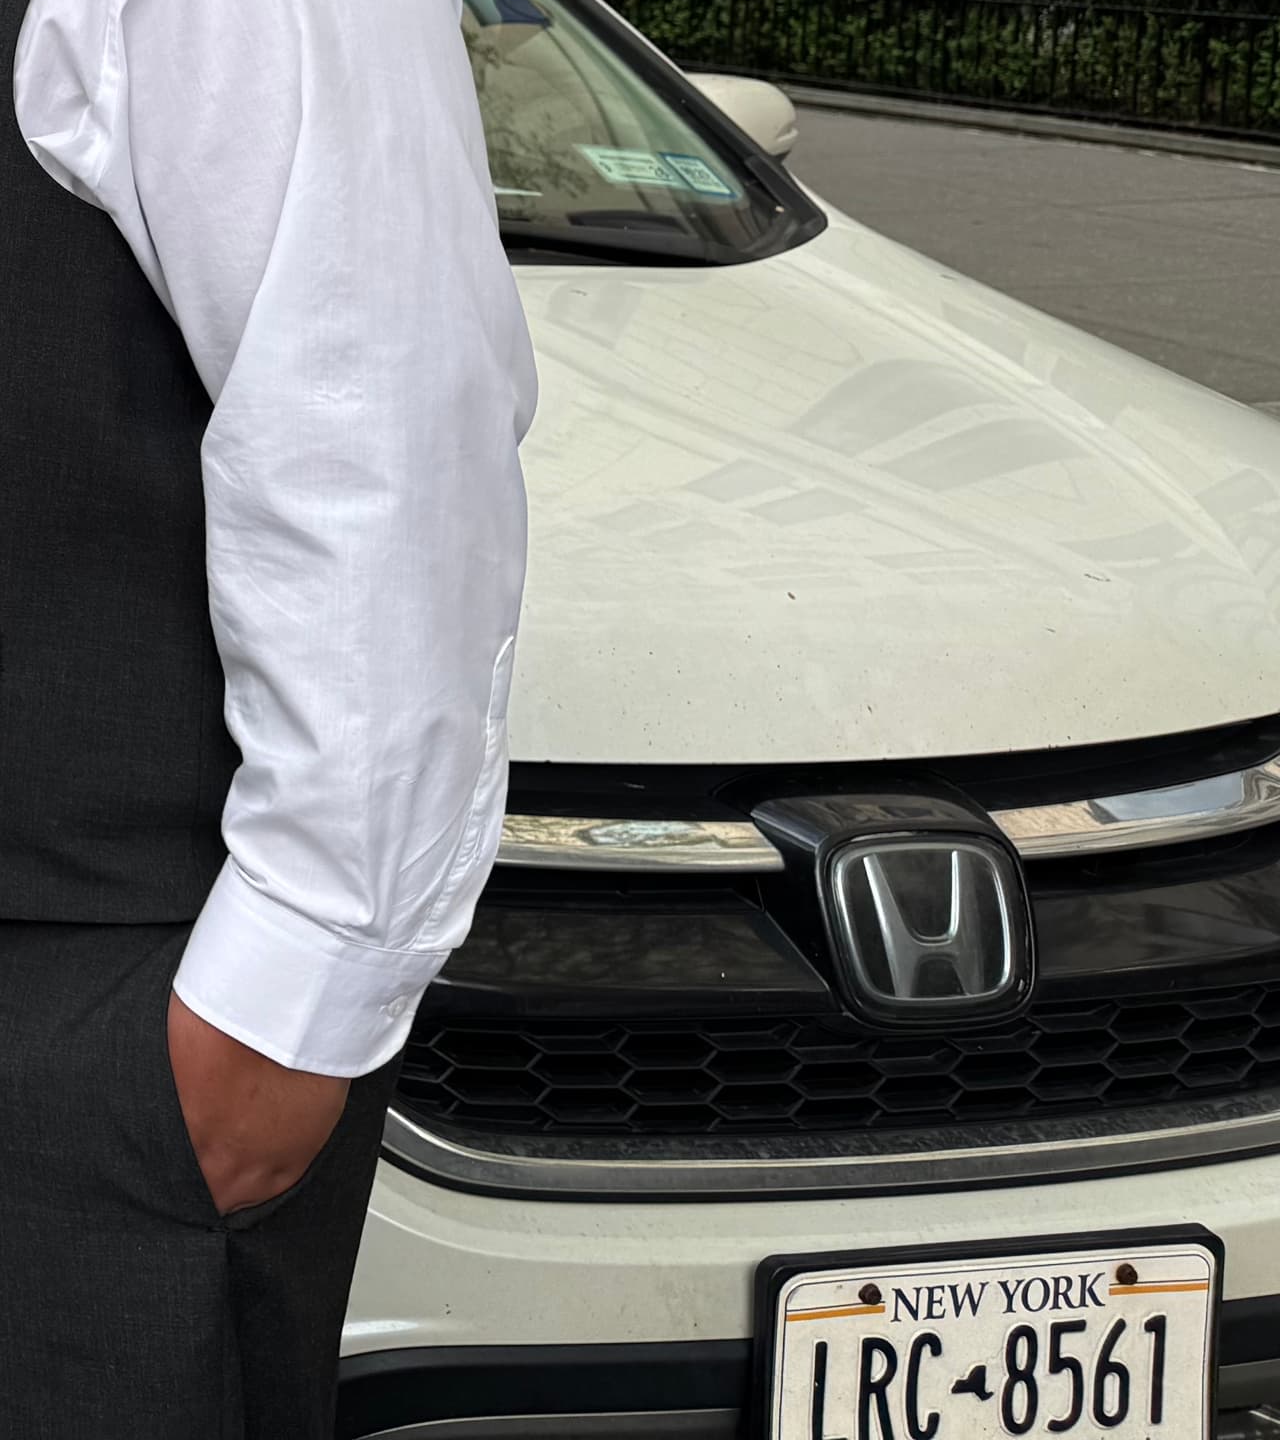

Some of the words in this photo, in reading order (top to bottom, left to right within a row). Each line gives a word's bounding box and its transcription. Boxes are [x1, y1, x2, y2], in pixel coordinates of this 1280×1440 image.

[890, 1281, 989, 1323] NEW
[997, 1272, 1106, 1315] YORK
[1000, 1314, 1167, 1435] 8561
